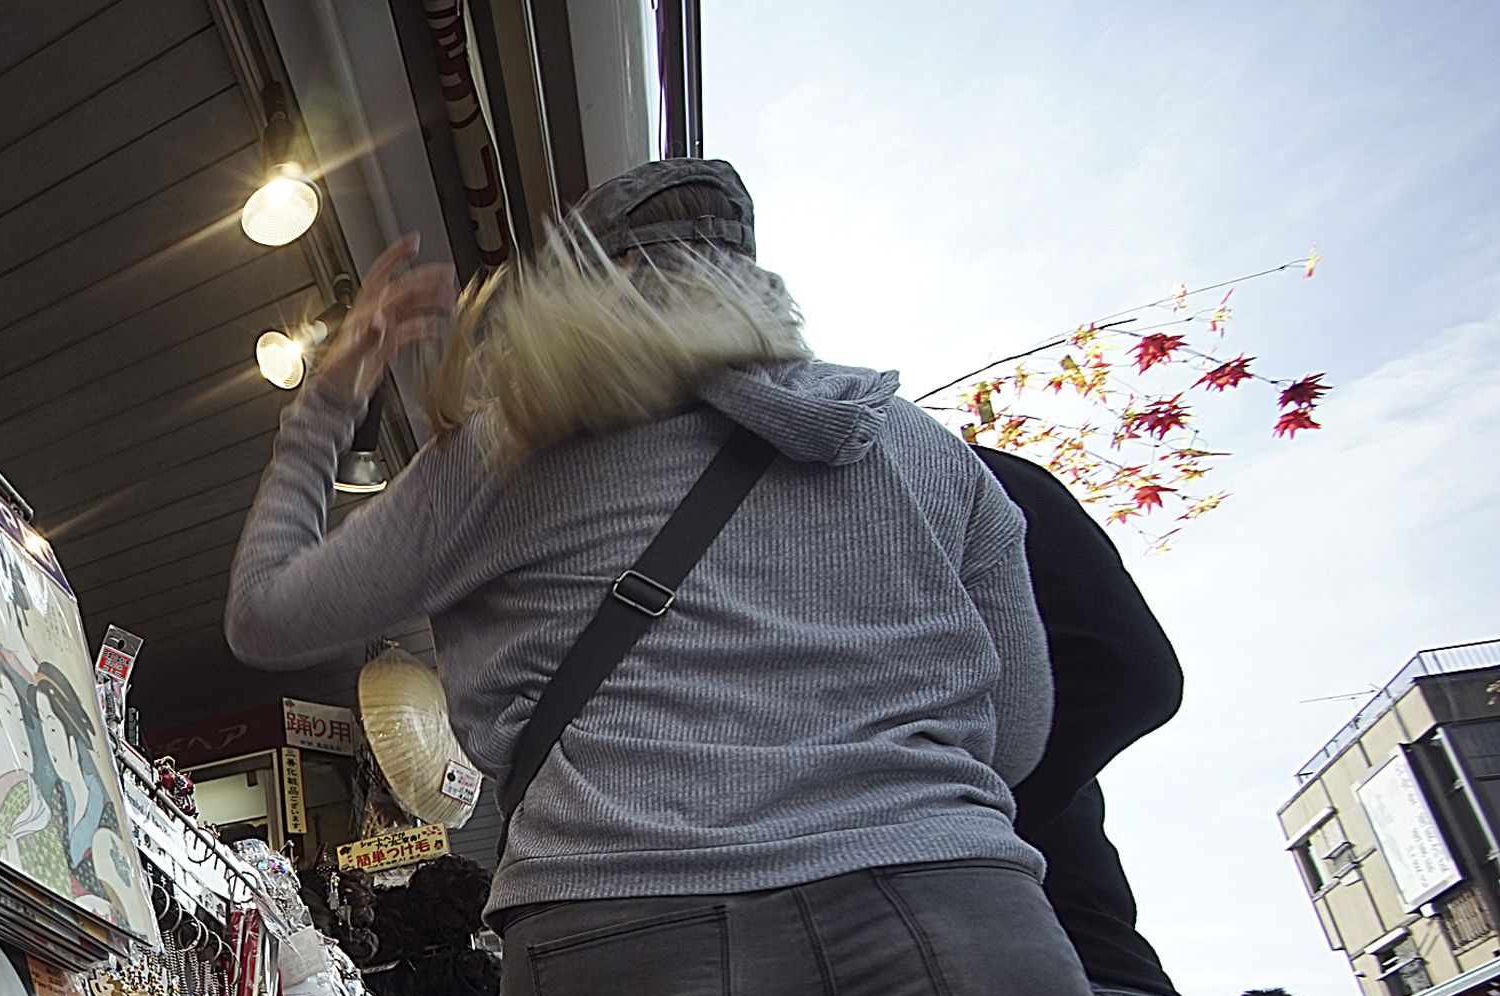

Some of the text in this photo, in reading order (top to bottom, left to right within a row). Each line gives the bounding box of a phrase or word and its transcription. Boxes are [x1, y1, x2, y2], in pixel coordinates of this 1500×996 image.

[285, 710, 352, 745] 踊り用
[355, 838, 431, 868] 簡単つけ毛
